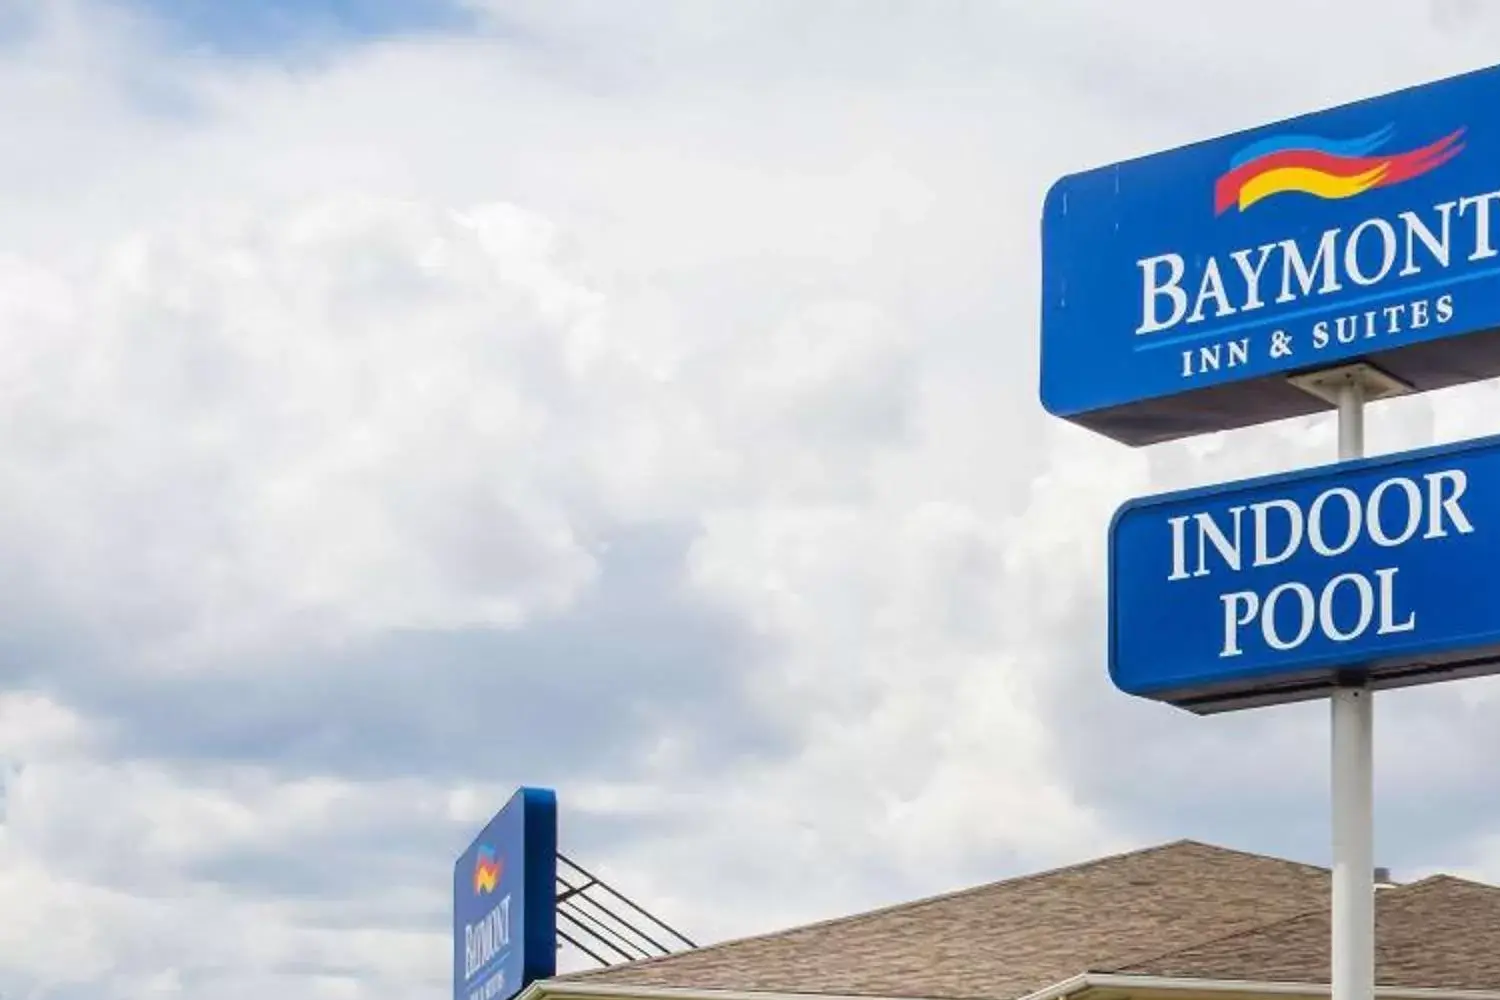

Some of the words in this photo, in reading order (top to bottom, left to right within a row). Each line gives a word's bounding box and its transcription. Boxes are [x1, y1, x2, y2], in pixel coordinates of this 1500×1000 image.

[1181, 339, 1249, 377] INN
[1270, 329, 1292, 359] &
[1312, 294, 1453, 349] SUITES
[1167, 469, 1474, 581] INDOOR
[1219, 567, 1415, 657] POOL
